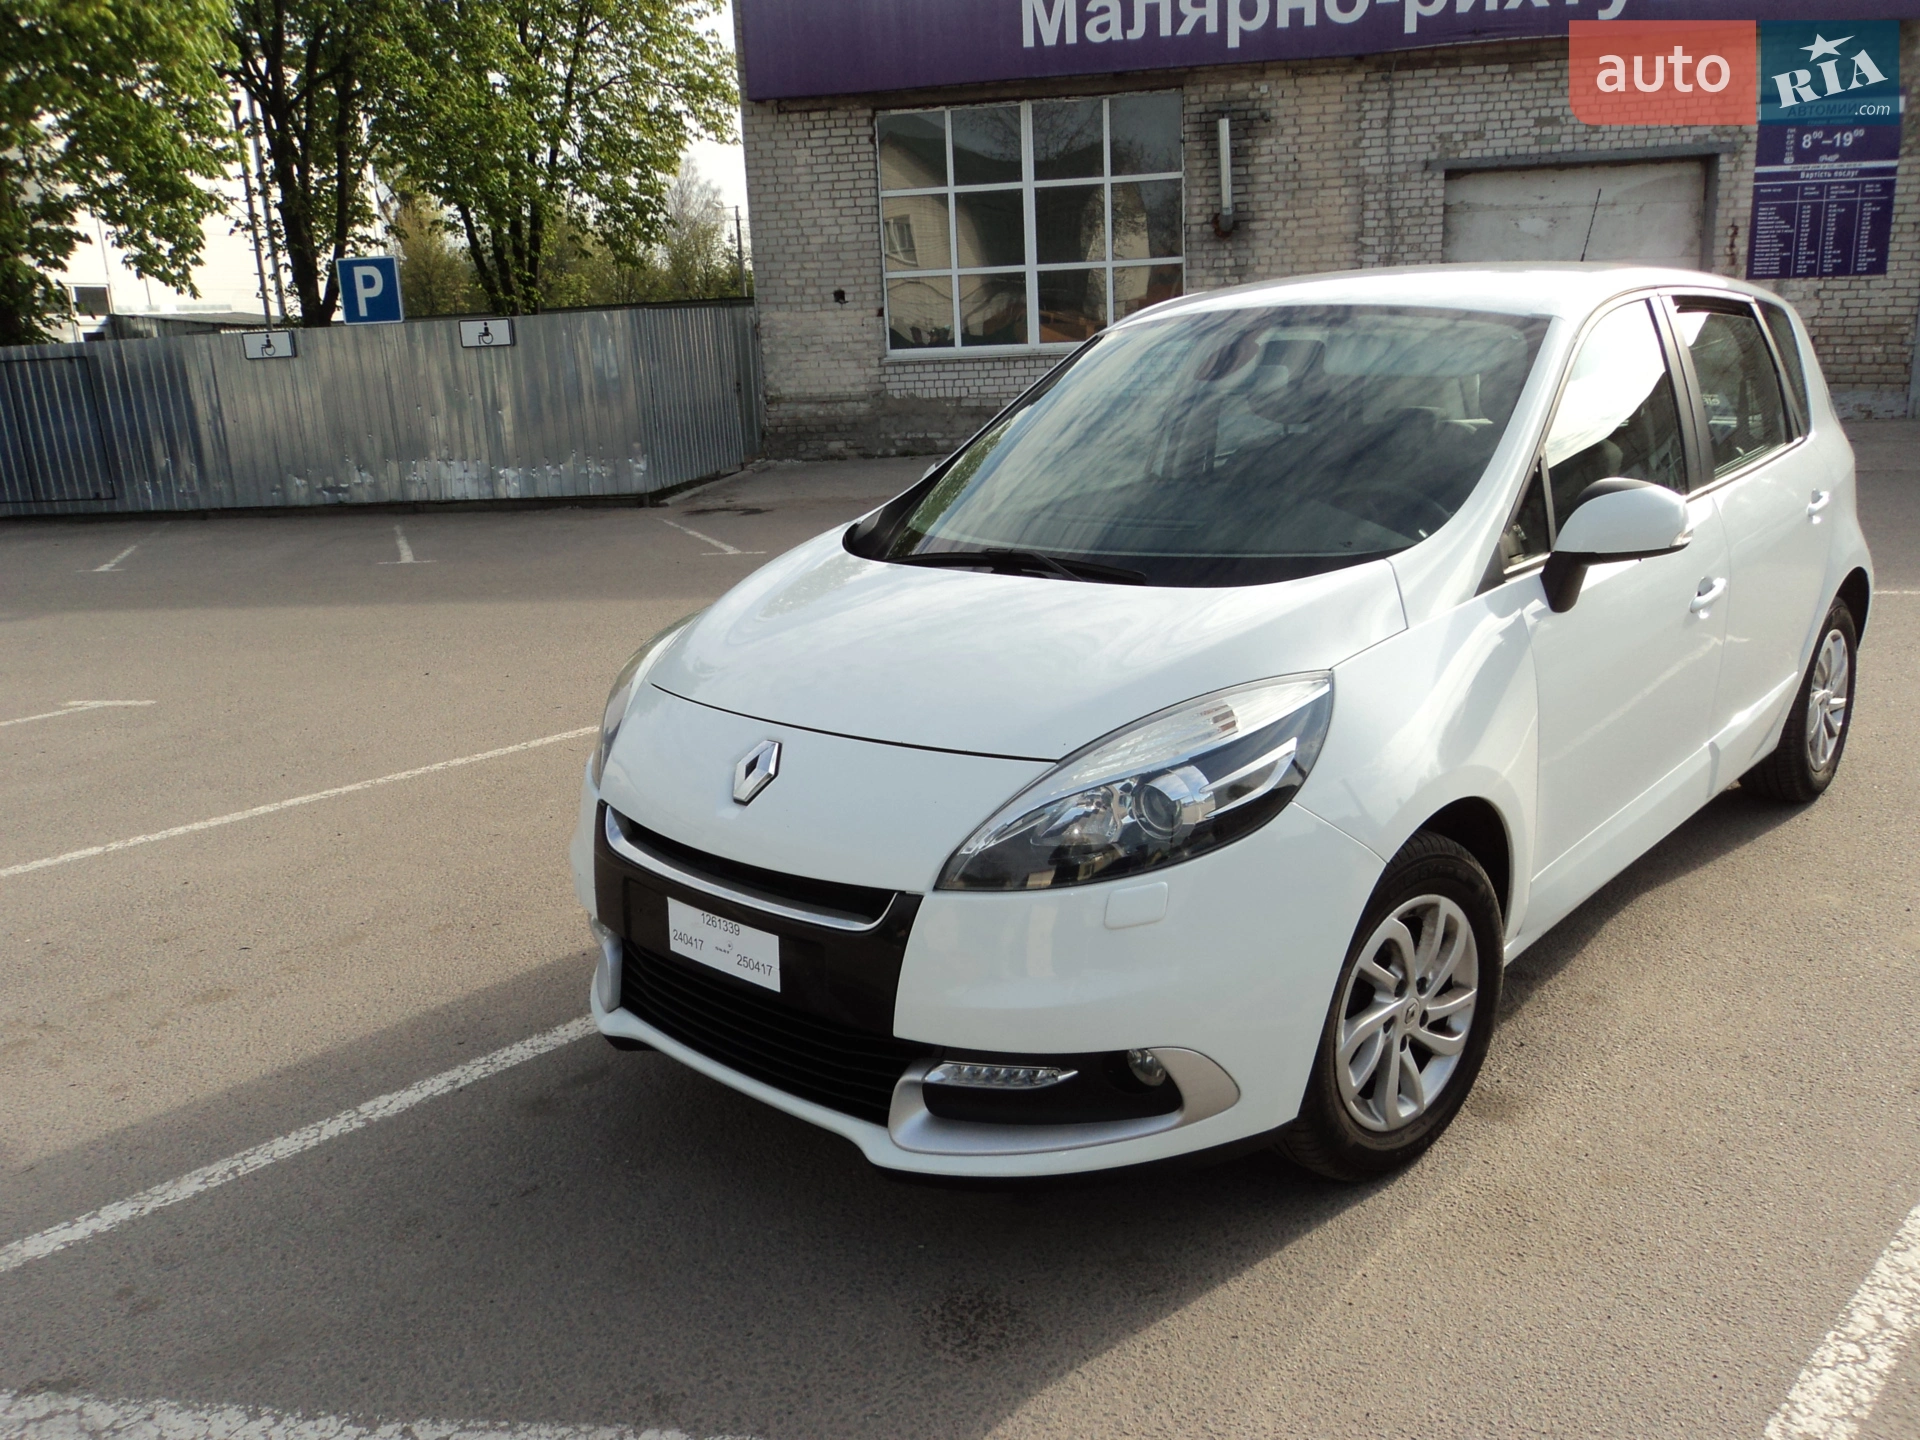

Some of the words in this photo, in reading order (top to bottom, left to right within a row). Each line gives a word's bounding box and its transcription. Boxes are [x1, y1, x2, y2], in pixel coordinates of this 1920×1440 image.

[1800, 171, 1831, 179] Вартість
[353, 266, 383, 317] P
[701, 912, 740, 936] 1261339
[673, 929, 704, 951] 240417
[736, 953, 773, 977] 250417
